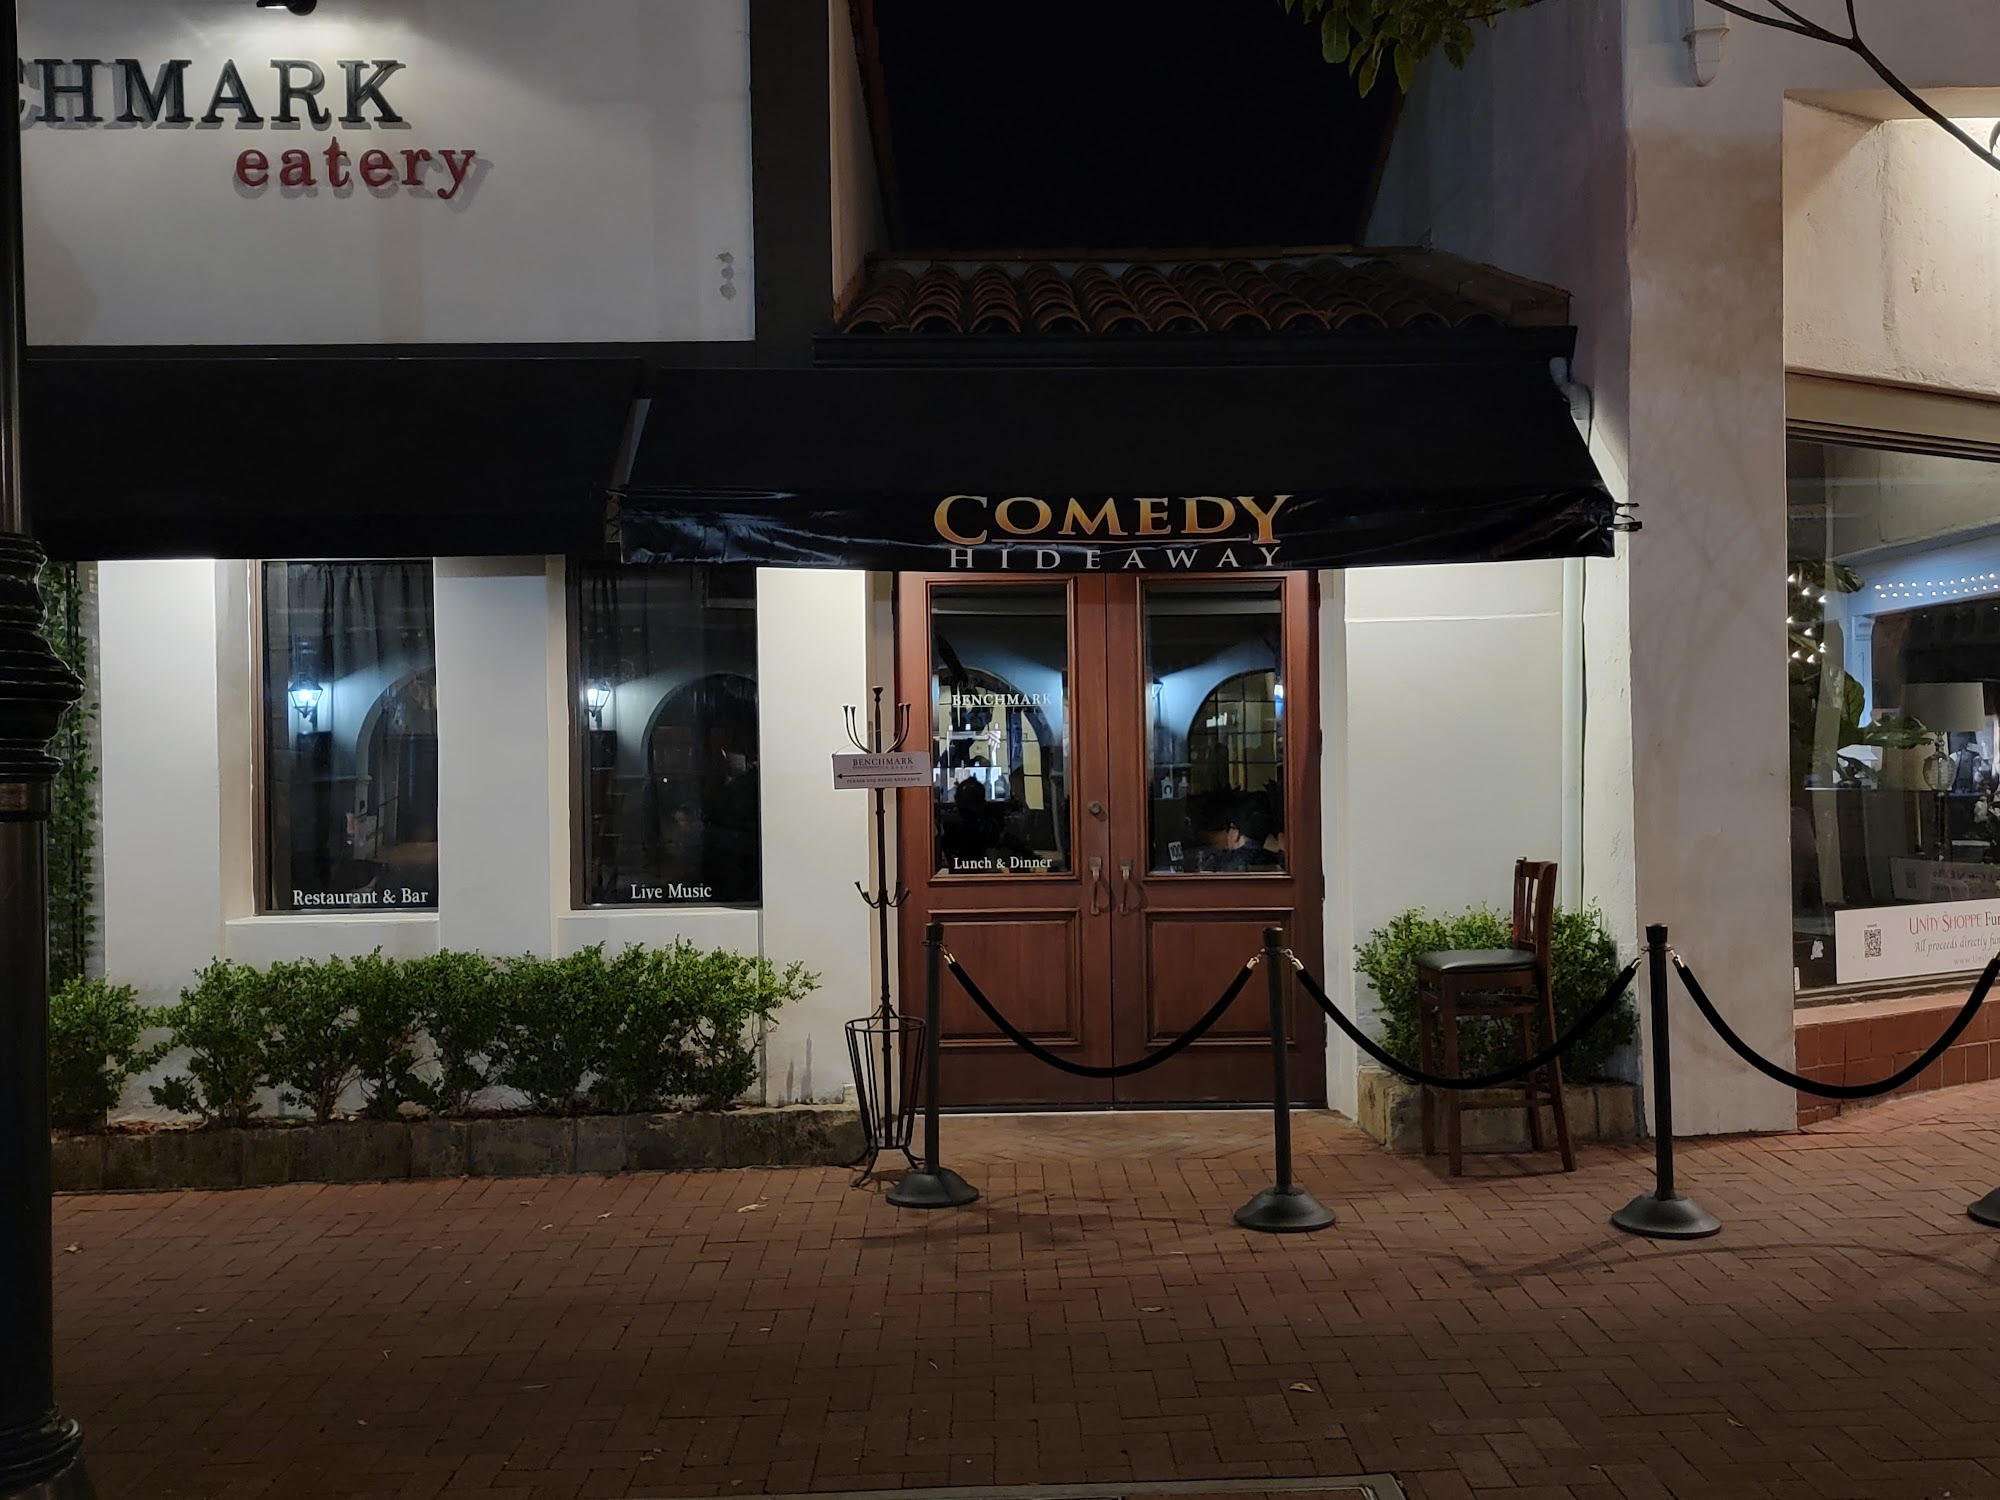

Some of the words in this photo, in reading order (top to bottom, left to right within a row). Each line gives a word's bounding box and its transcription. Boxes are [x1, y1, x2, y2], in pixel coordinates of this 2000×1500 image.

[19, 57, 407, 124] HMARK
[236, 136, 477, 200] eatery
[934, 494, 1295, 546] COMEDY
[949, 547, 1285, 571] HIDEAWAY
[951, 693, 1052, 707] BENCHMARK
[852, 756, 914, 767] BENCHMARK
[953, 856, 992, 870] Lunch
[996, 857, 1006, 869] &
[1010, 856, 1053, 868] Dinner
[292, 889, 378, 906] Restaurant
[382, 889, 396, 904] &
[400, 887, 429, 903] Bar
[630, 883, 663, 900] Live
[667, 882, 713, 899] Music
[1927, 936, 1957, 957] proceeds
[1959, 934, 1987, 951] directly
